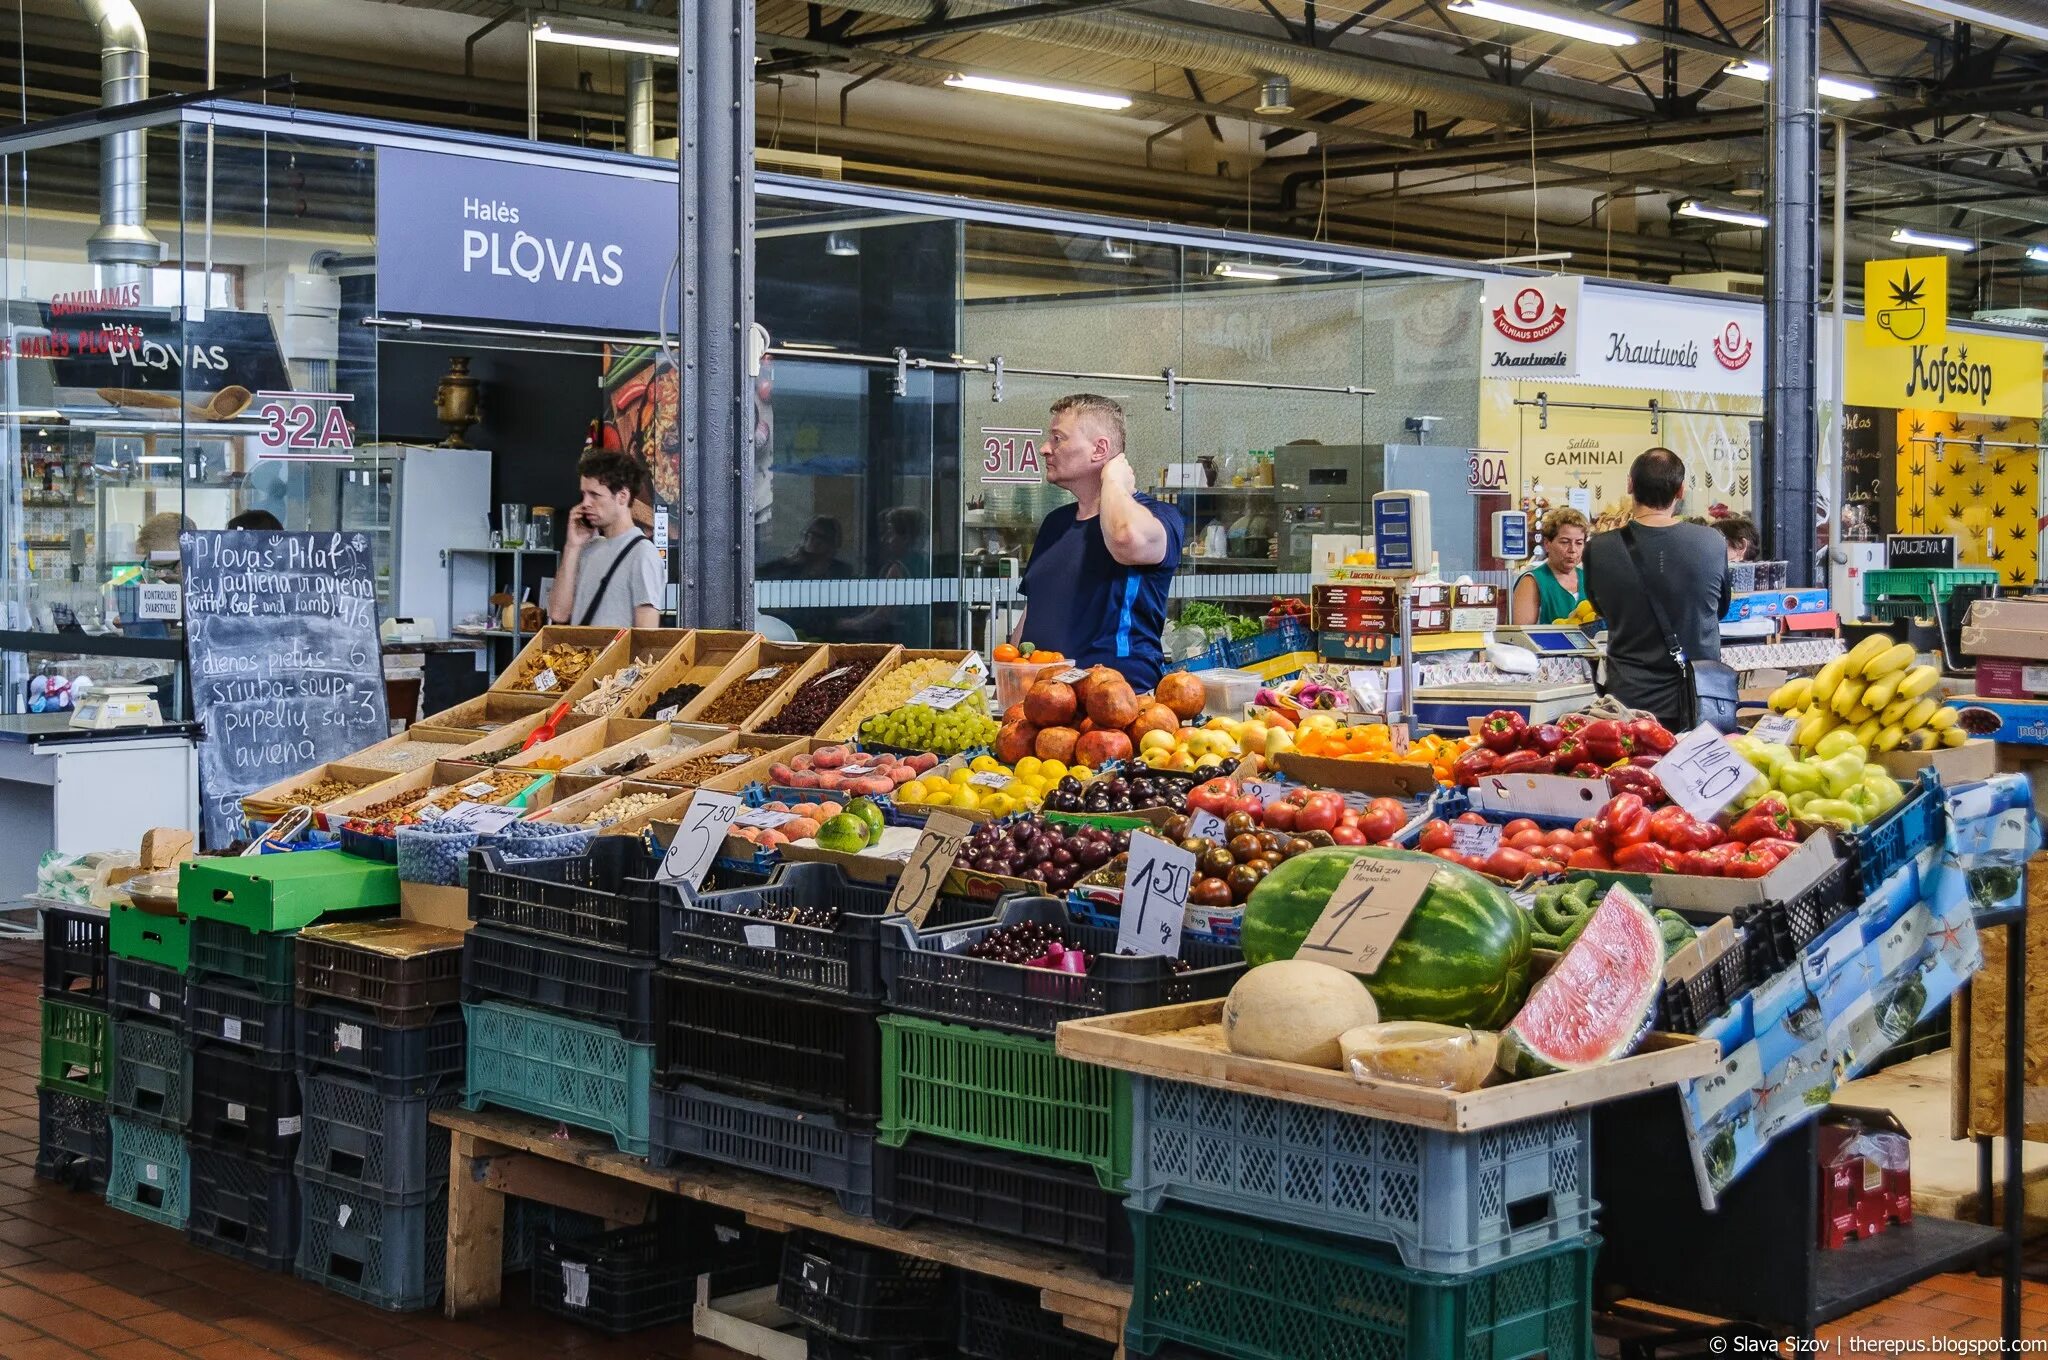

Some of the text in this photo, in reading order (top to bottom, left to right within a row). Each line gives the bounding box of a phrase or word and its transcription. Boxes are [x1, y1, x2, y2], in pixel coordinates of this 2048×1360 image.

[463, 197, 519, 224] Halės
[463, 230, 624, 286] PLOVAS
[1499, 319, 1532, 340] VILNIAUS
[1532, 320, 1561, 340] DUONA
[108, 340, 229, 371] PLOVAS
[260, 405, 354, 450] 32A
[983, 436, 1041, 474] 31A
[1544, 450, 1624, 466] GAMINIAI
[1467, 456, 1509, 487] 30A
[1159, 921, 1173, 945] kg
